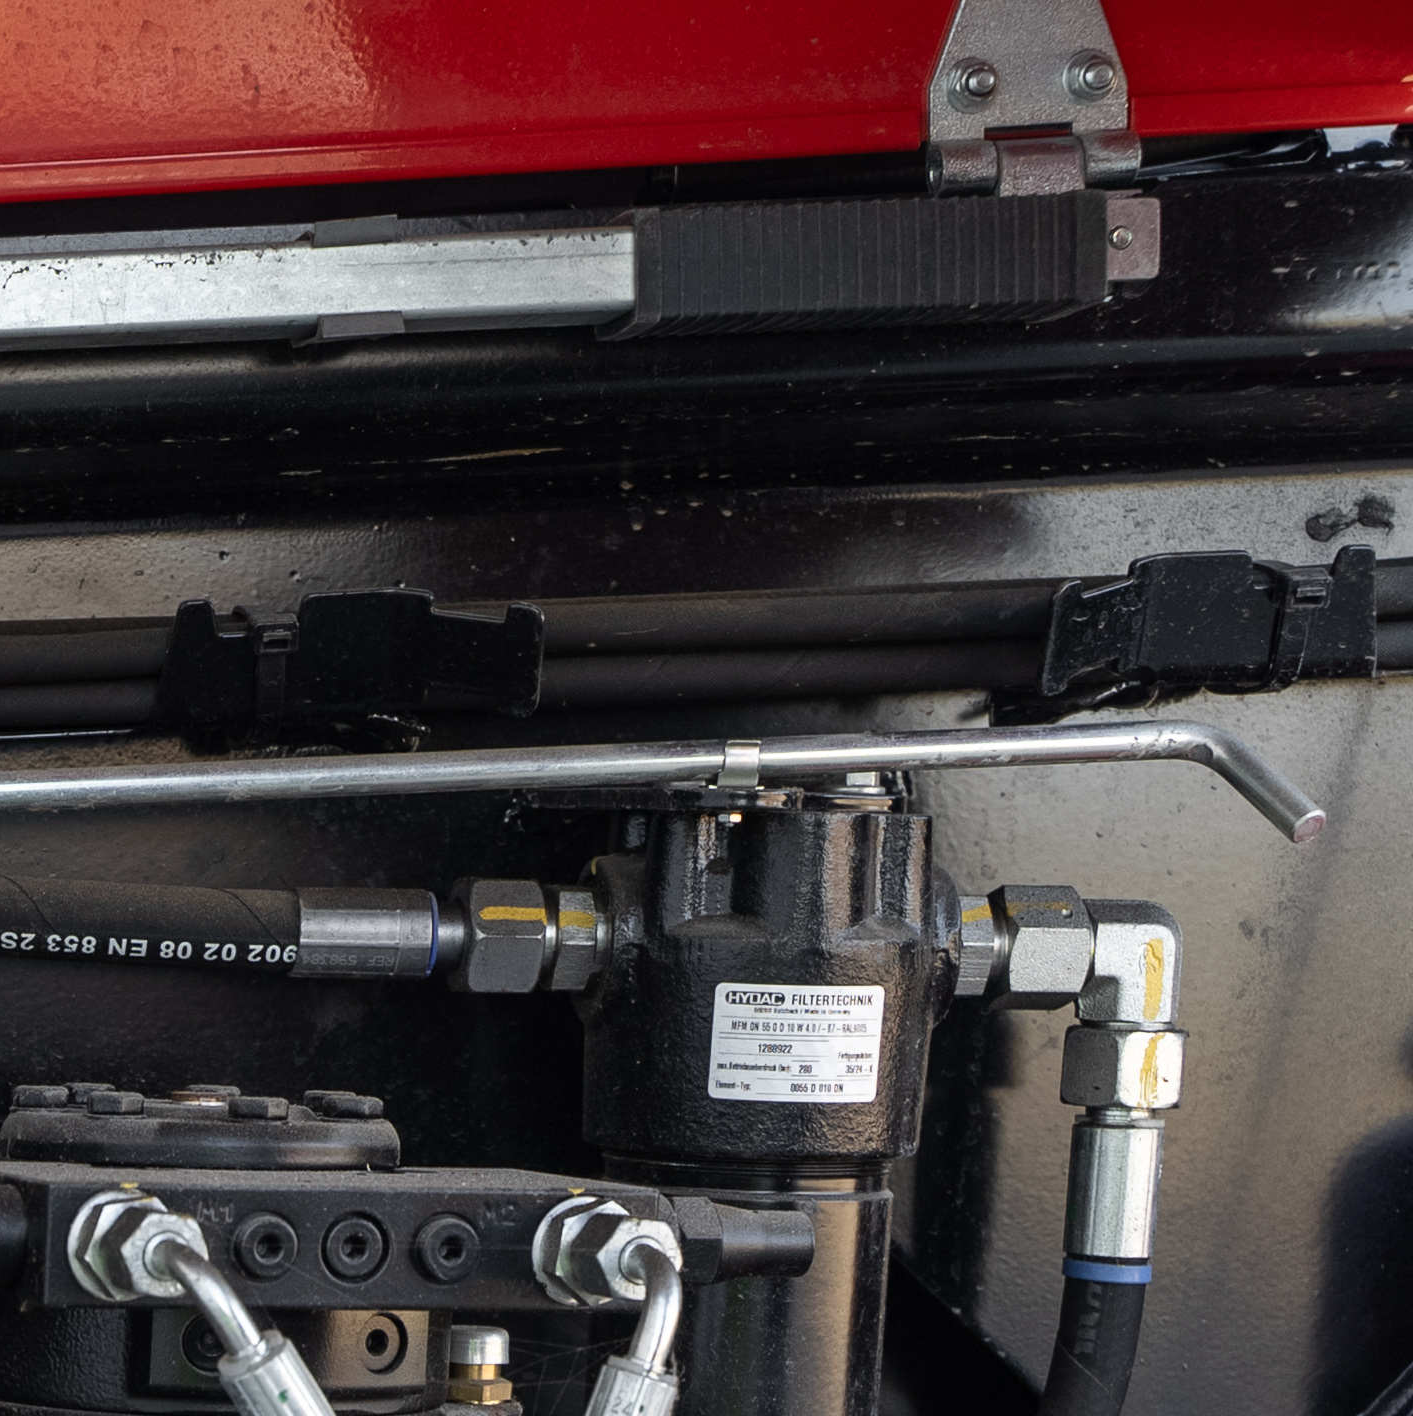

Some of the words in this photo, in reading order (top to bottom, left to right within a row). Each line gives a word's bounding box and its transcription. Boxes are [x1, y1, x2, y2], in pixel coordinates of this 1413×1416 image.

[47, 934, 96, 954] 853
[108, 937, 147, 957] EN
[159, 941, 192, 960] 08
[203, 943, 236, 962] 02
[248, 944, 297, 964] 902
[726, 991, 785, 1006] HYDAC
[791, 993, 874, 1007] FILTERTECHNIK
